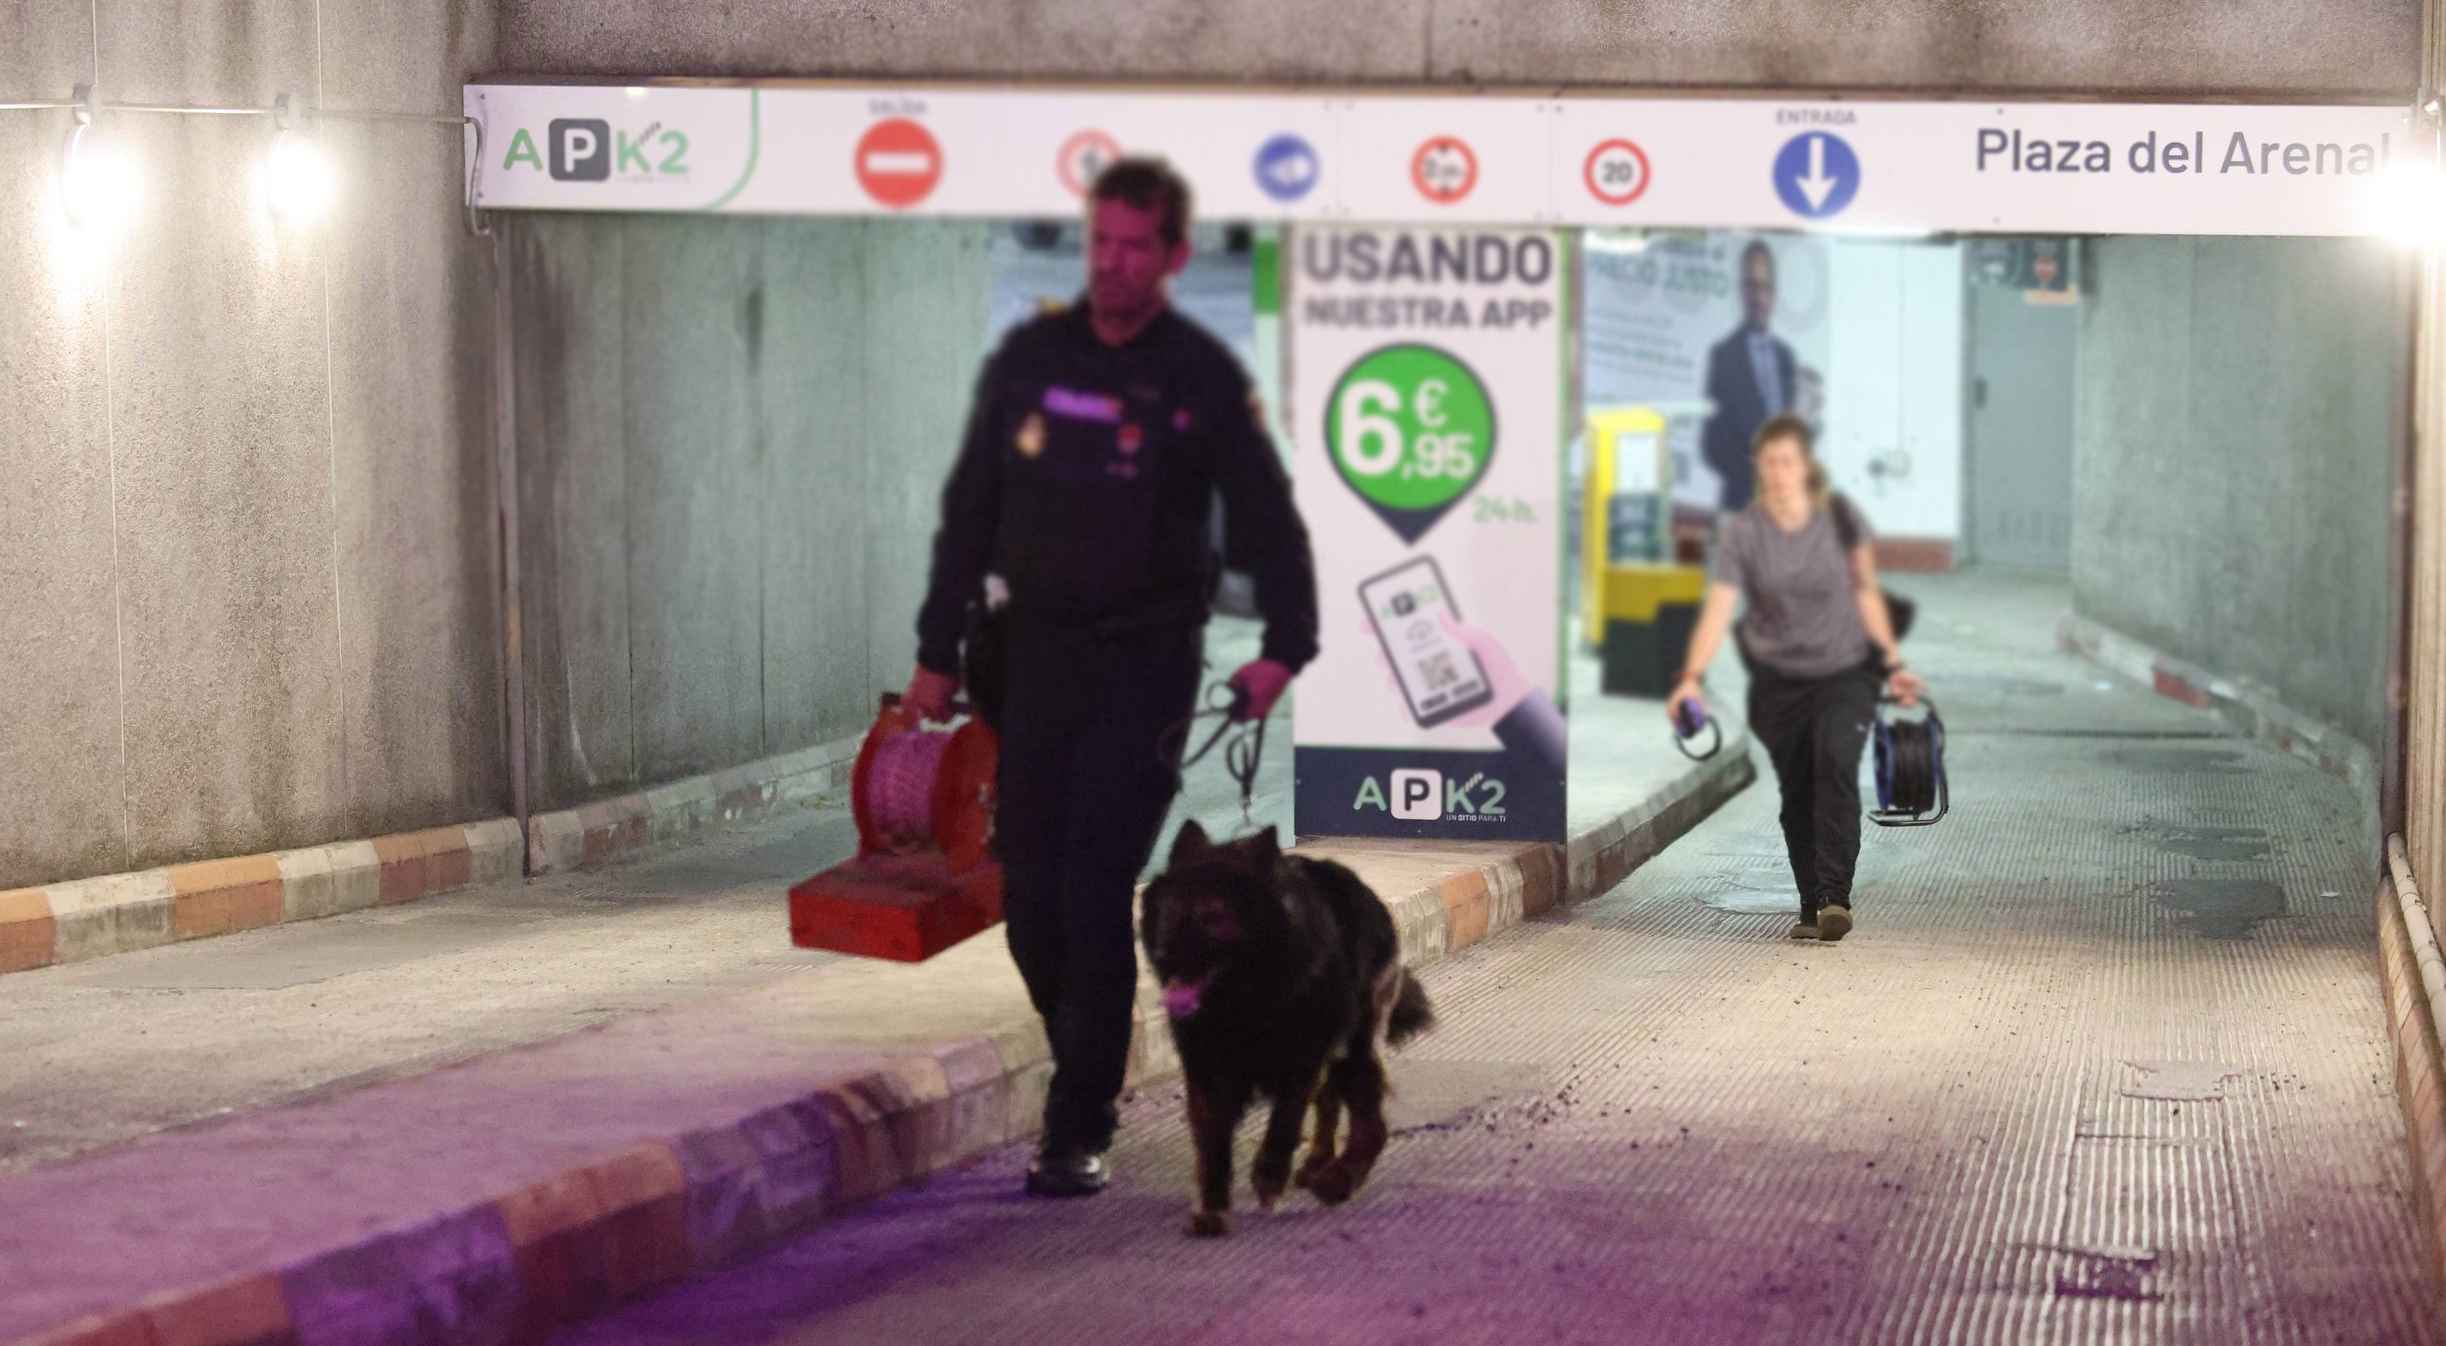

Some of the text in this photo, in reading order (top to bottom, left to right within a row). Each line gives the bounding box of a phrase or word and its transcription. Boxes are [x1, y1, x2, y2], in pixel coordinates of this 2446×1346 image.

[1776, 108, 1857, 125] ENTRADA
[1978, 129, 2391, 175] Plaza del Arenal
[1603, 161, 1634, 183] 20
[1304, 235, 1551, 285] USANDO
[1305, 299, 1552, 328] NUESTRA APP
[1457, 814, 1478, 822] SITIO
